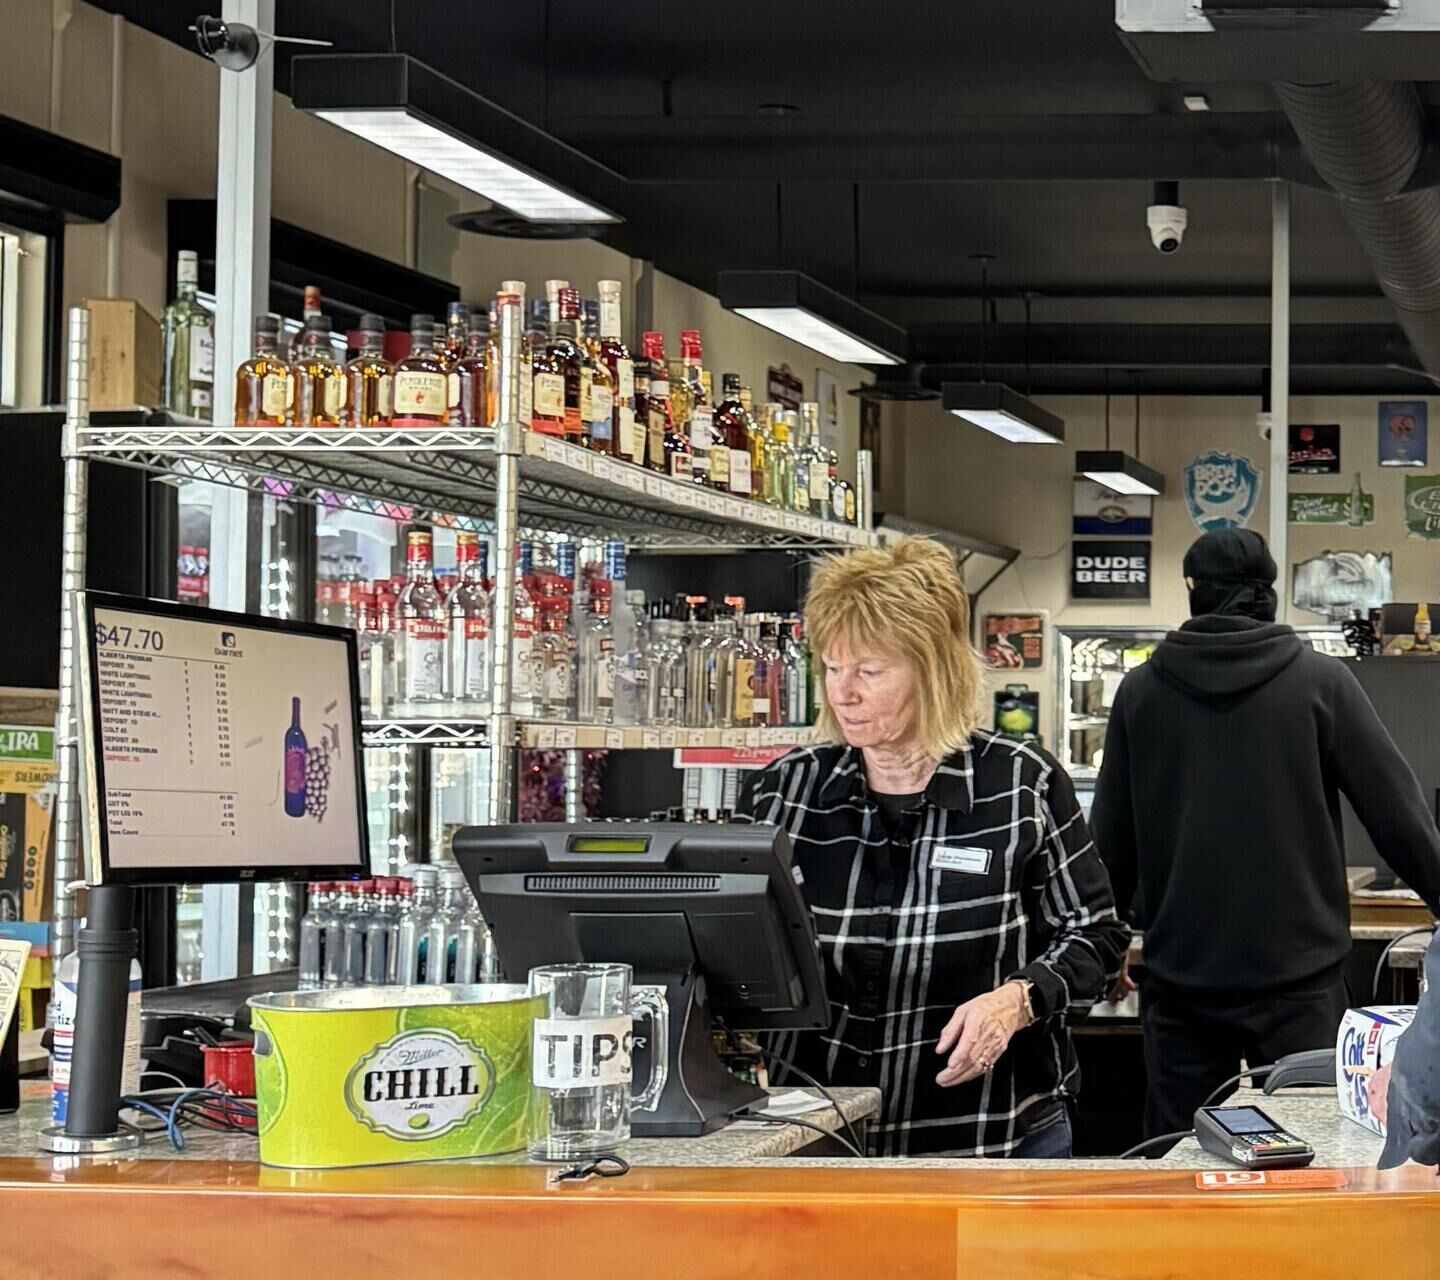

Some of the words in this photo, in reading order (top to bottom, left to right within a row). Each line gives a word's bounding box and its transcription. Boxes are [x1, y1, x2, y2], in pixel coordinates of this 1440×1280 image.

[1076, 556, 1147, 570] DUDE
[1076, 570, 1147, 584] BEER
[95, 622, 164, 651] $47.70
[539, 1030, 633, 1079] TIPS
[364, 1064, 479, 1102] CHILL
